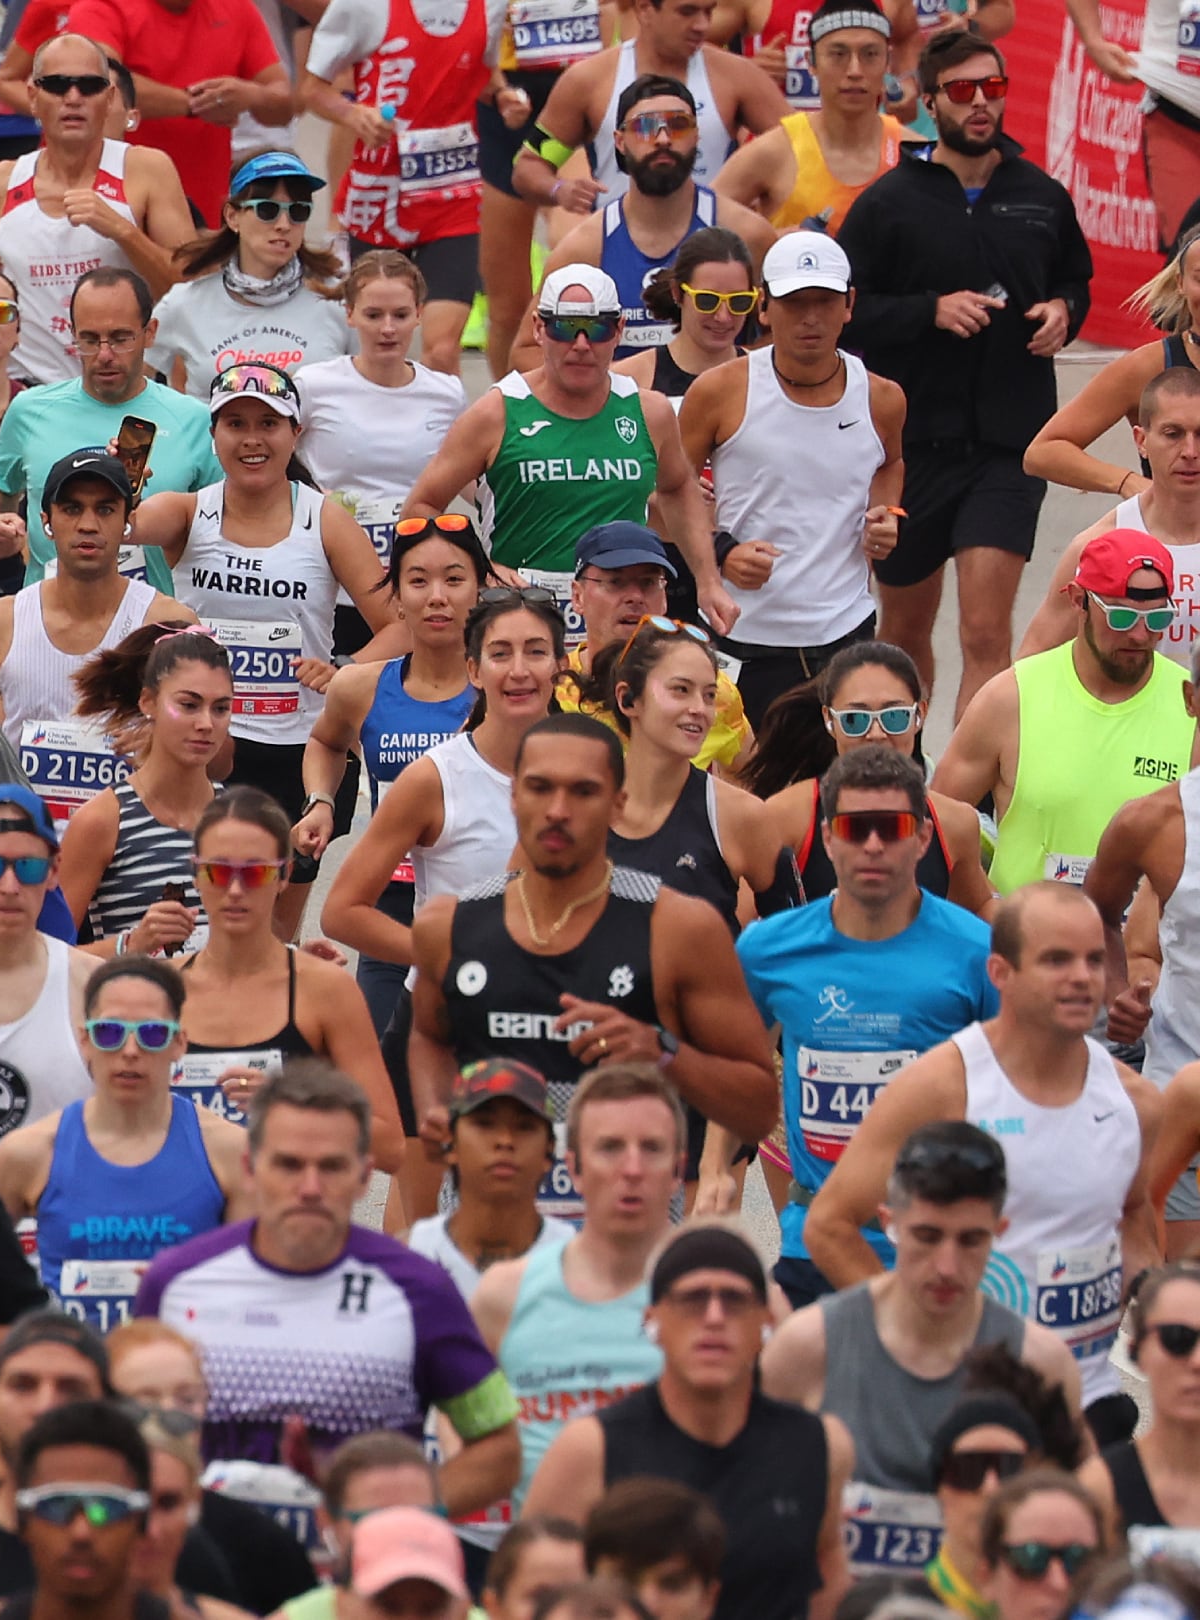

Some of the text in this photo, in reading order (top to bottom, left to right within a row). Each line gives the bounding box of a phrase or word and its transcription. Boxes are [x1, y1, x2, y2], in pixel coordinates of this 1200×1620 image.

[514, 17, 599, 47] D 14695
[1180, 22, 1197, 46] D
[786, 70, 803, 94] D
[402, 154, 417, 177] D
[30, 259, 102, 278] KIDS FIRST
[211, 326, 308, 357] BANK OF AMERICA
[216, 349, 303, 375] Chicago
[519, 459, 641, 483] IRELAND
[225, 555, 263, 572] THE
[192, 567, 308, 601] WARRIOR
[273, 627, 291, 636] RUN
[22, 750, 130, 784] D 21566
[802, 1080, 819, 1116] D
[86, 1215, 176, 1245] BRAVE
[339, 1272, 374, 1311] H
[1038, 1289, 1057, 1322] C
[841, 1522, 931, 1563] D 123
